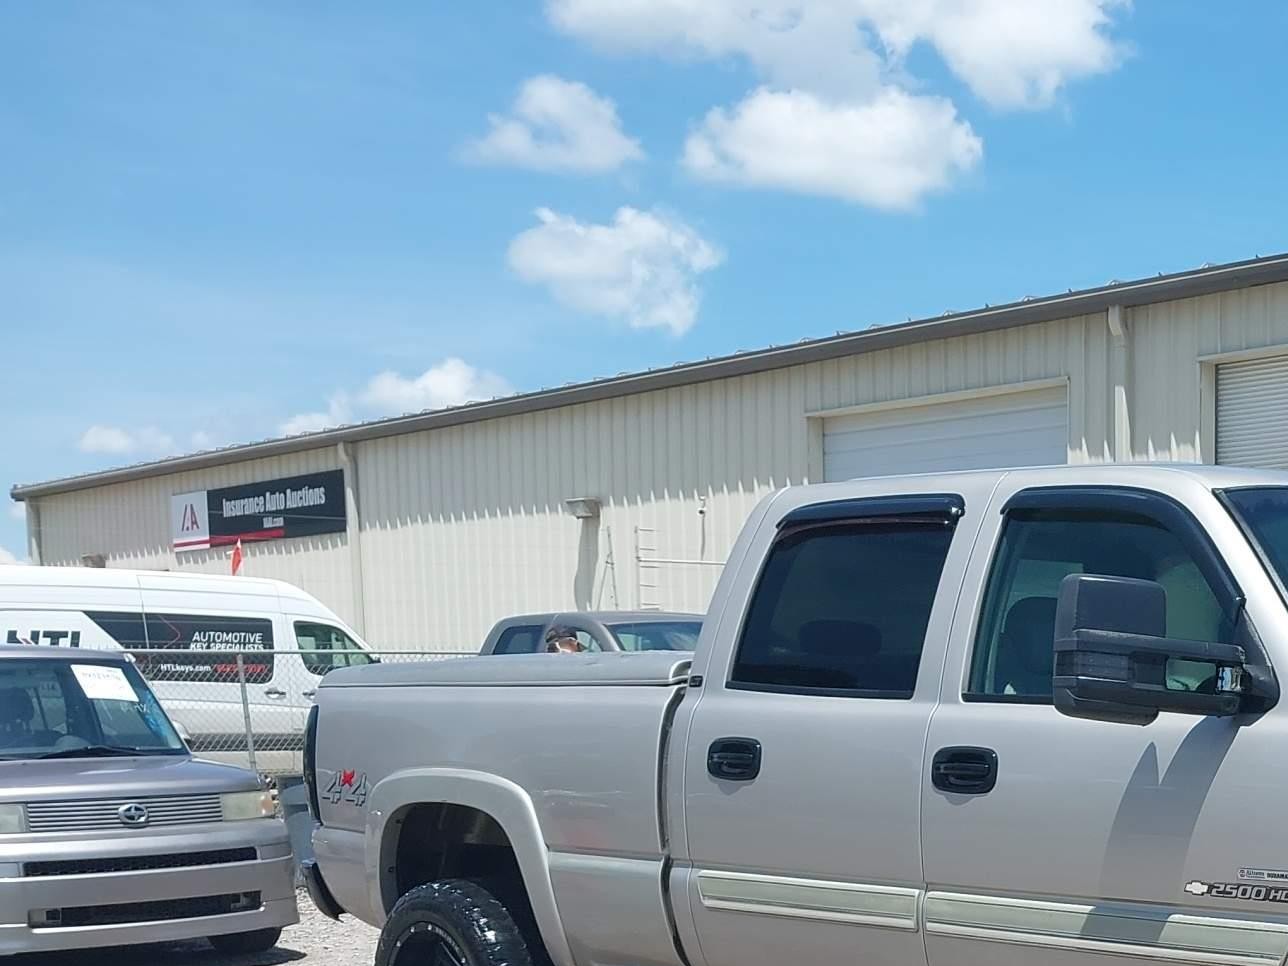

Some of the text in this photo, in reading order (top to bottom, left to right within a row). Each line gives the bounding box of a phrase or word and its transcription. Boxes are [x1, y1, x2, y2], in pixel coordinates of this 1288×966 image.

[222, 485, 326, 518] Insurance Auto Auctions
[191, 631, 263, 643] AUTOMOTIVE
[189, 643, 264, 651] KEY SPECIALISTS
[1210, 883, 1267, 900] 2500
